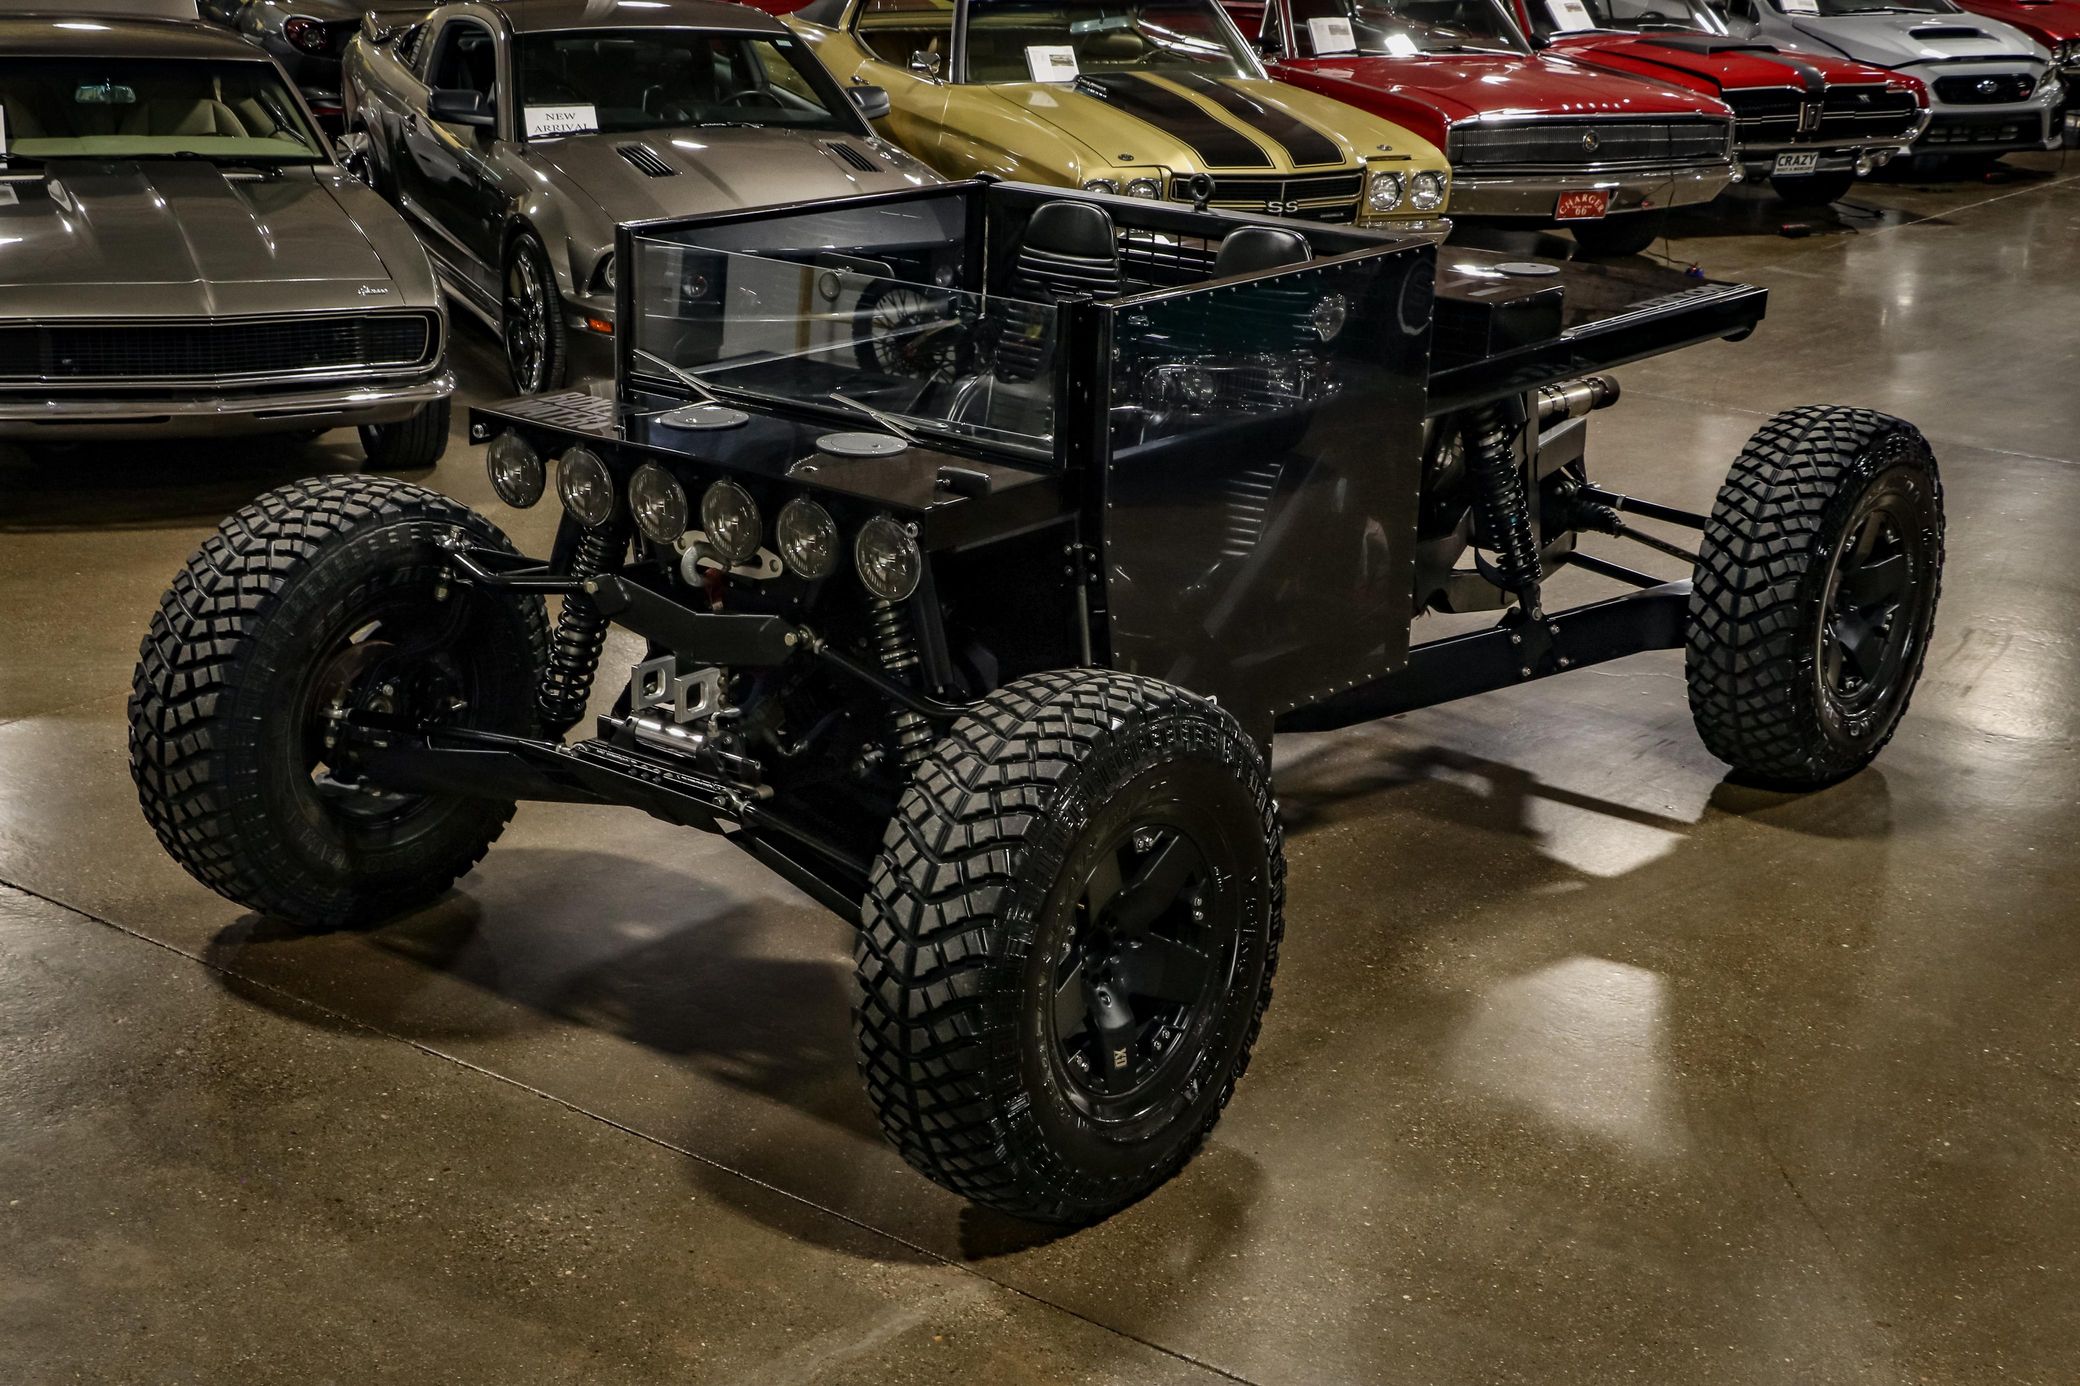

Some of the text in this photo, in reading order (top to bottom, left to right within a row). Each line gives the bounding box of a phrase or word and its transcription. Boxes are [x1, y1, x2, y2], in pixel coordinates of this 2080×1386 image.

[545, 112, 576, 121] NEW
[1778, 154, 1817, 167] CRAZY
[1267, 200, 1299, 213] SS
[1559, 193, 1604, 214] CHARGER
[1575, 206, 1587, 216] 66
